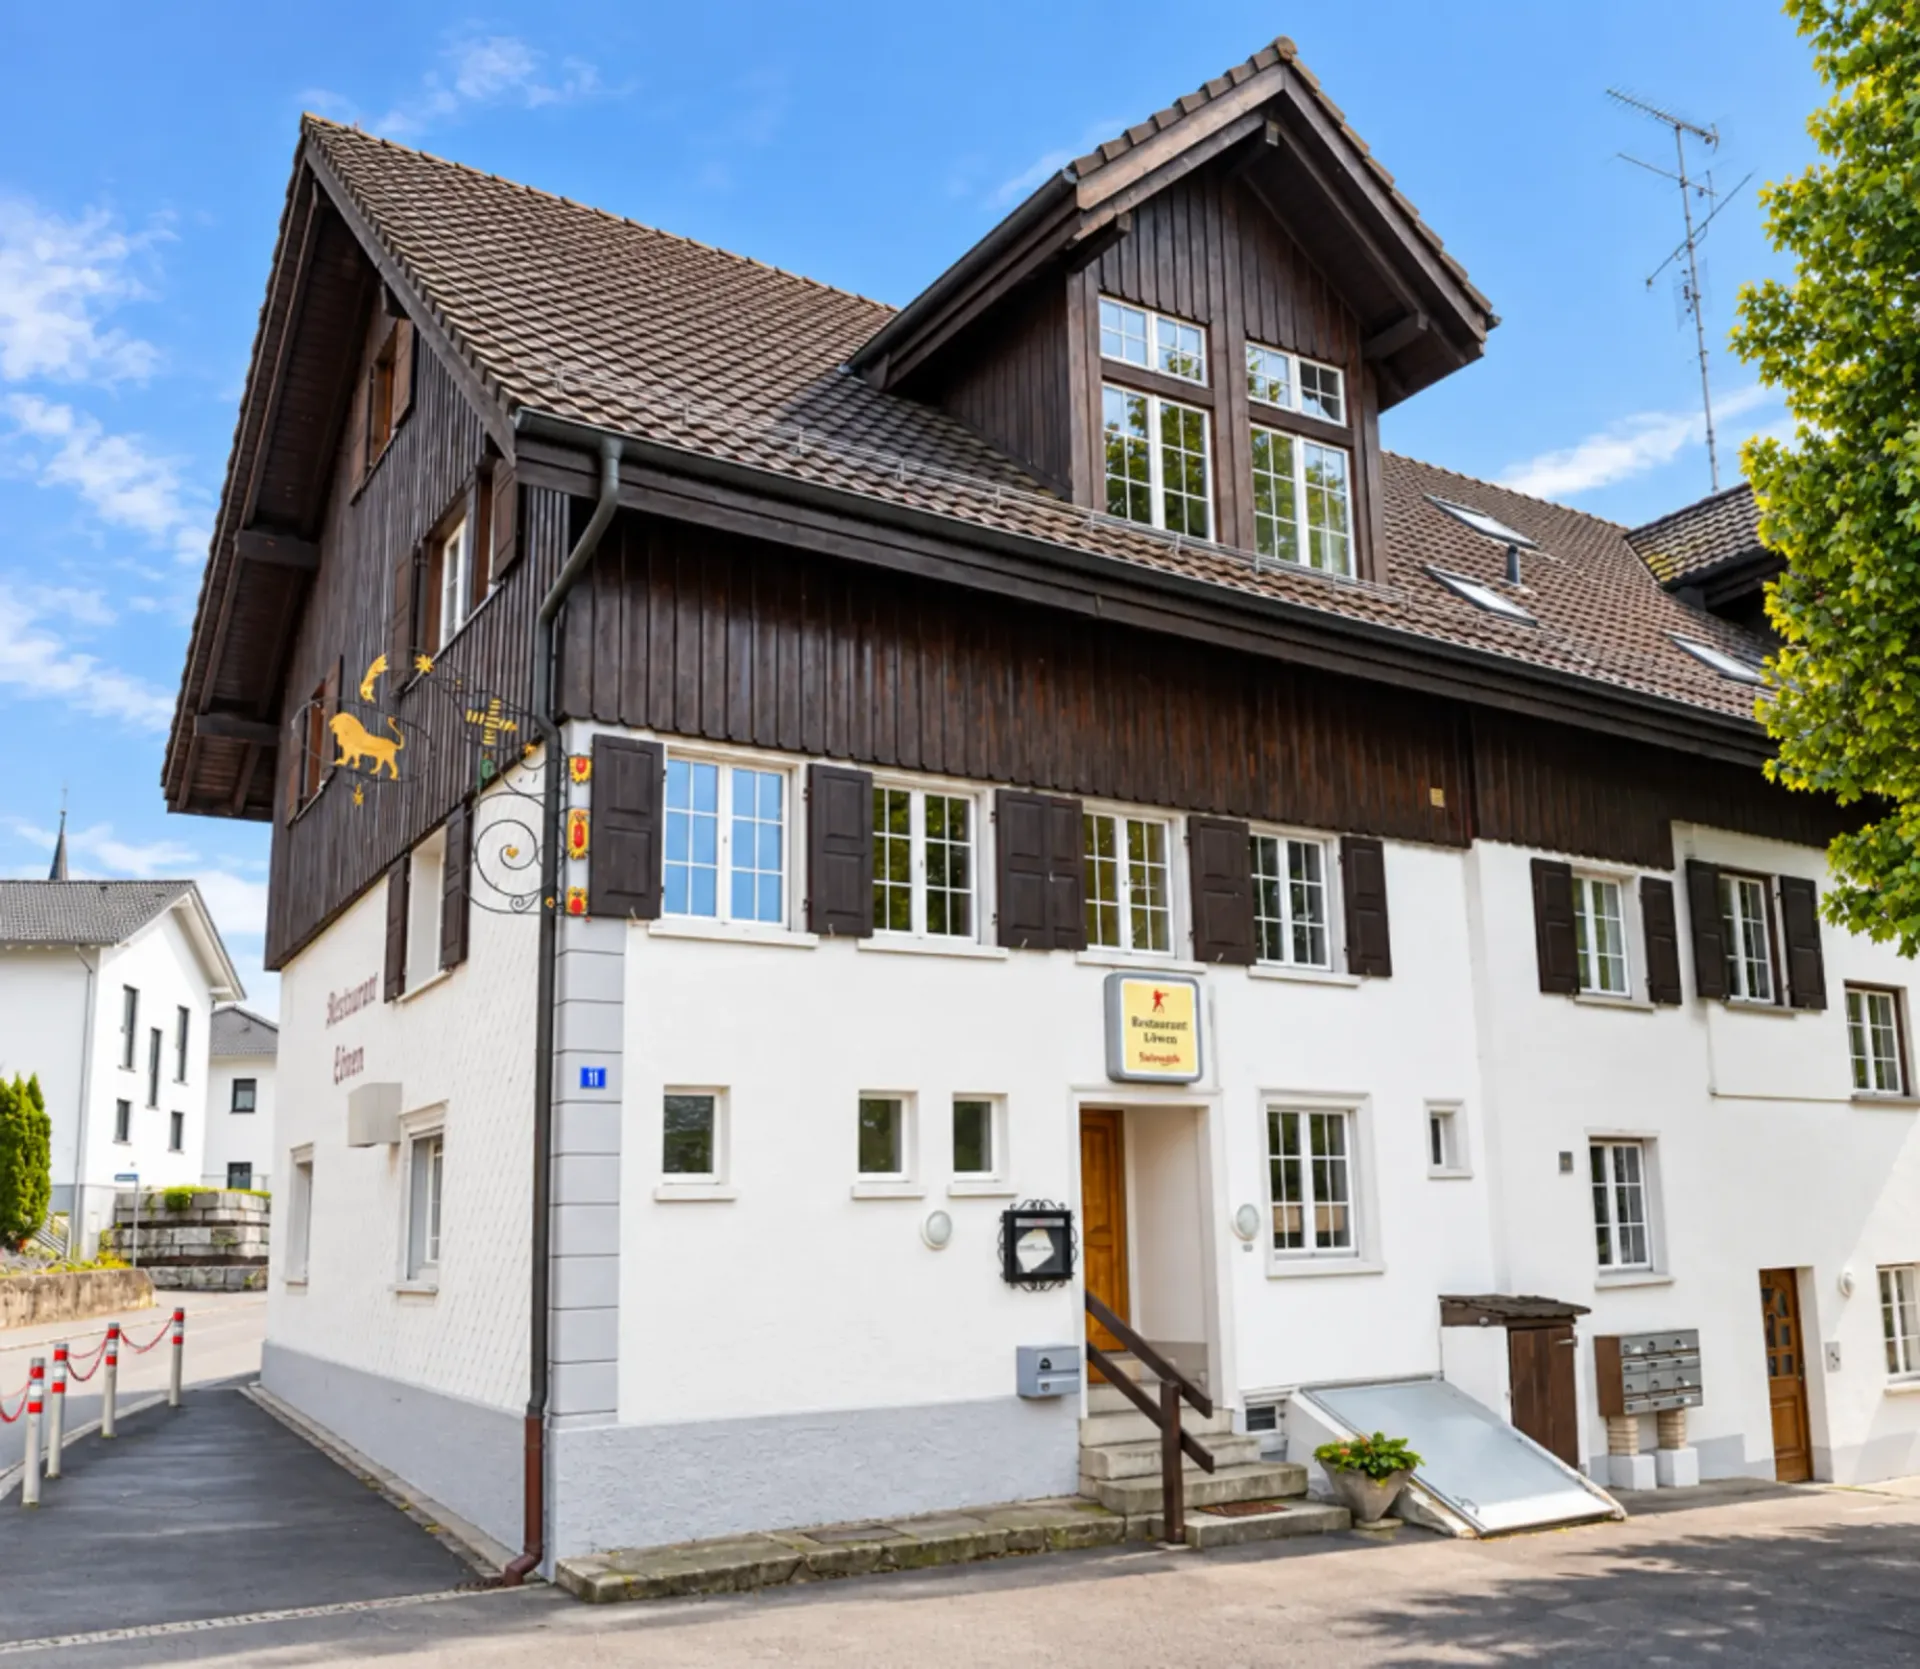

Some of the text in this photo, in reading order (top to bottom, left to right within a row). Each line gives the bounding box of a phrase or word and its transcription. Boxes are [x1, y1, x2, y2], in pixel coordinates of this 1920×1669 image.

[325, 972, 377, 1028] Restaurant
[1131, 1016, 1188, 1031] Restaurant
[1143, 1032, 1177, 1045] Löwen
[588, 1071, 598, 1086] 11
